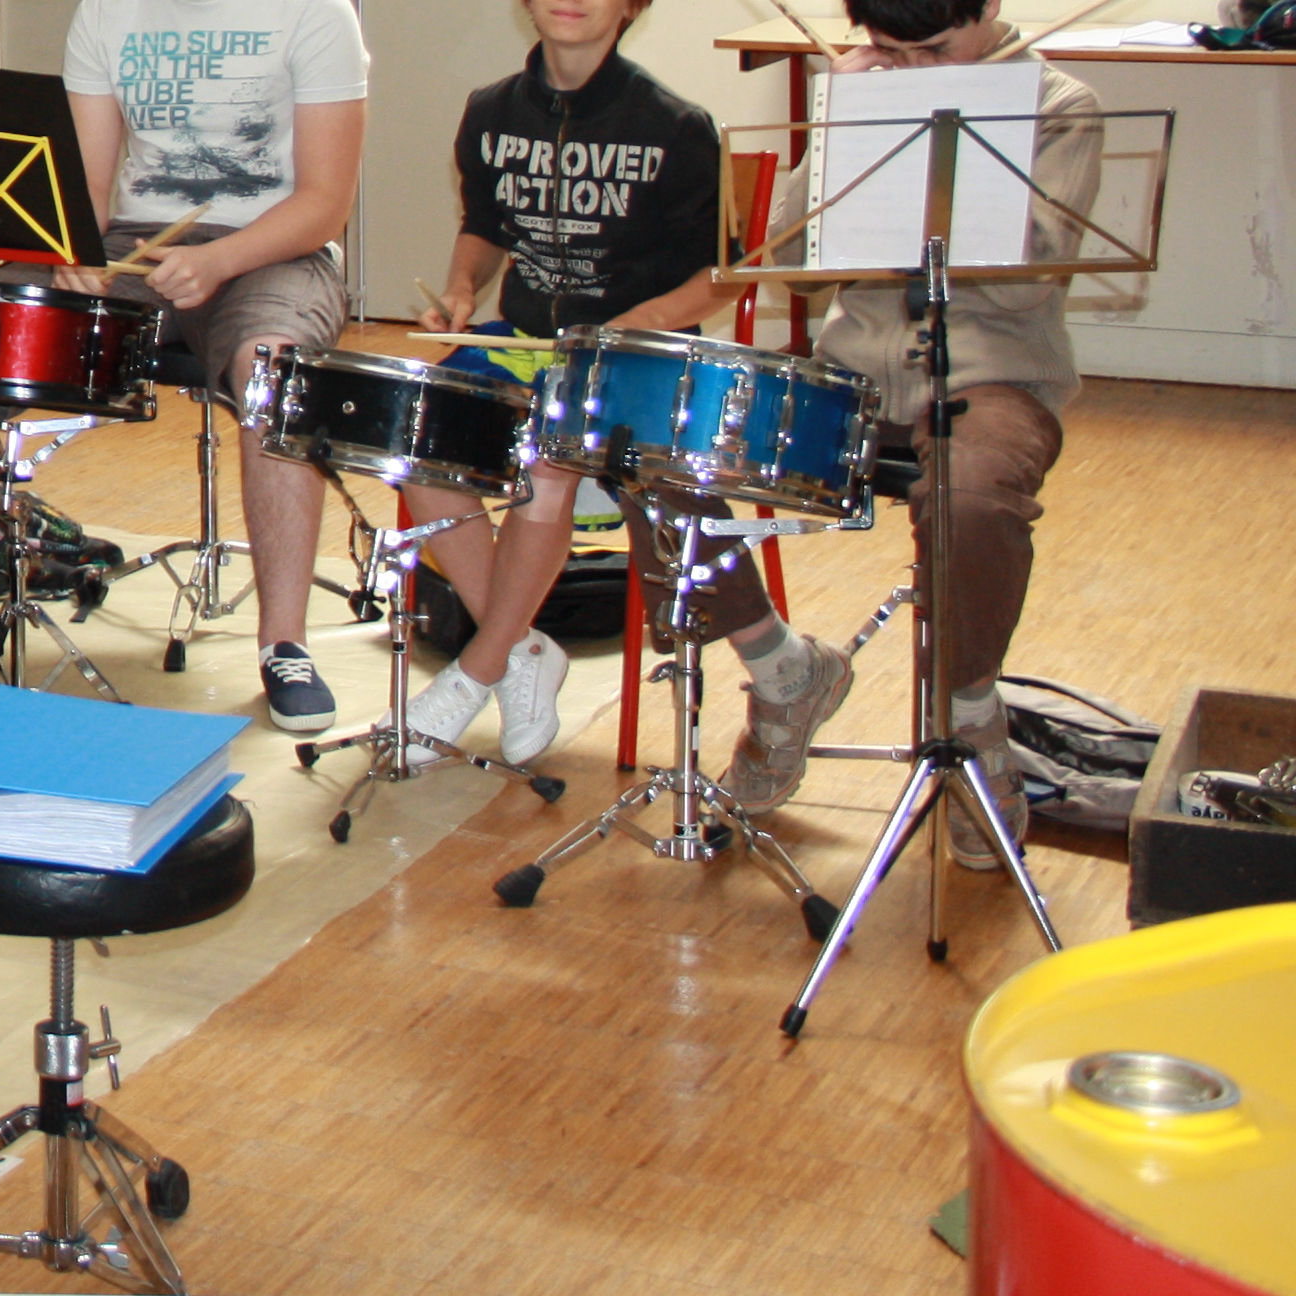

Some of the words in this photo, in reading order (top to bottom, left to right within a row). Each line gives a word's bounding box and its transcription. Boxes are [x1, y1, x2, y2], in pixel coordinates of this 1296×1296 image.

[120, 32, 181, 55] AND
[187, 31, 272, 55] SURF
[119, 55, 159, 80] ON
[167, 55, 224, 79] THE
[117, 81, 194, 105] TUBE
[495, 172, 630, 217] ACTION
